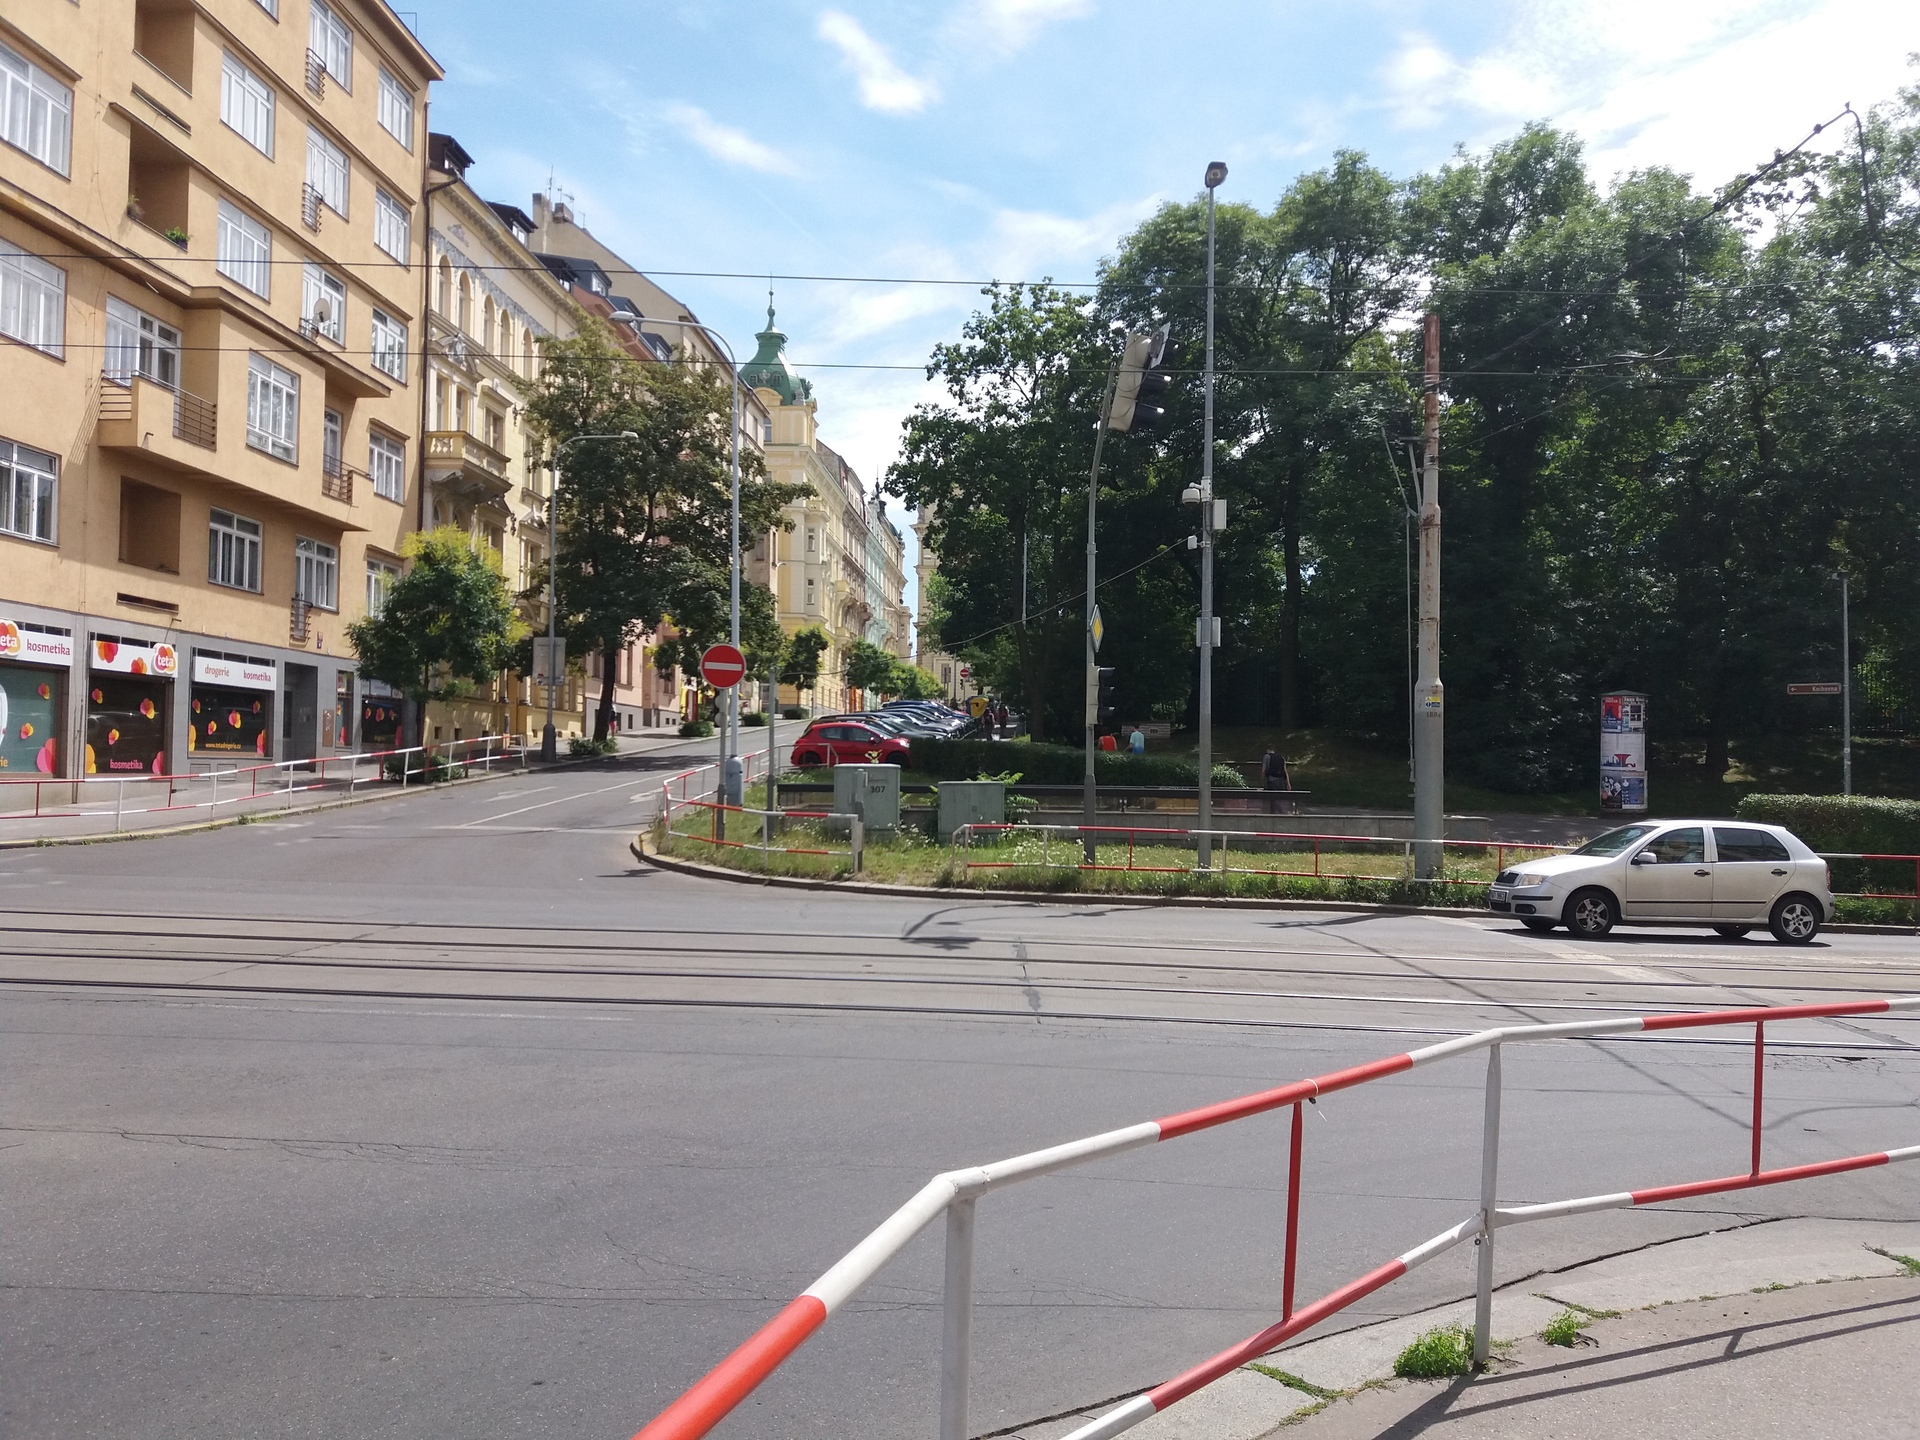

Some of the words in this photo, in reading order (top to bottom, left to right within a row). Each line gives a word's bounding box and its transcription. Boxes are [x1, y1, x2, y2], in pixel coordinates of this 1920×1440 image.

[0, 634, 17, 648] eta
[26, 638, 71, 656] kosmetika
[157, 655, 174, 667] teta
[204, 664, 230, 678] drogerie
[243, 669, 272, 682] kosmetika
[110, 759, 143, 769] kosmetika
